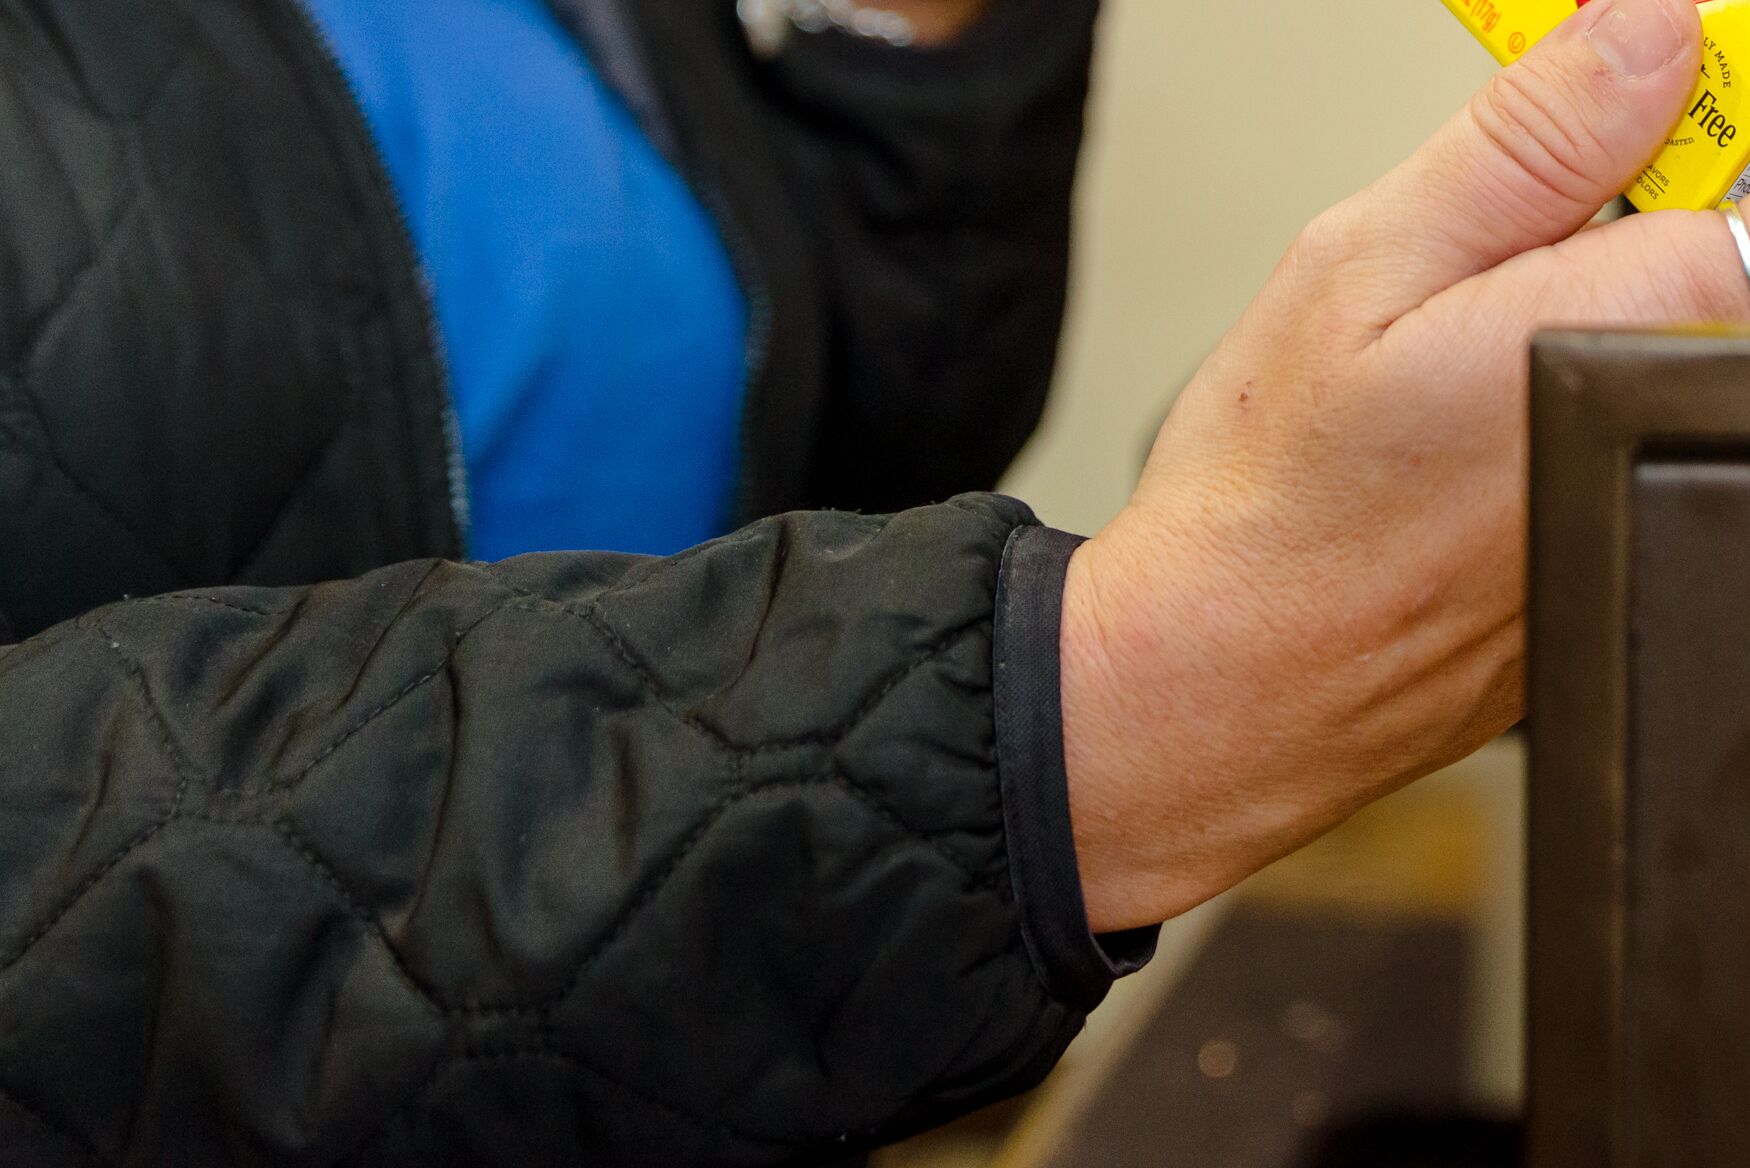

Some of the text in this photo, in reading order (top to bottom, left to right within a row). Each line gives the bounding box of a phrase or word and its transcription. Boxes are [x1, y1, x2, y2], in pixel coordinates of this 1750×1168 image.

[1714, 50, 1732, 89] MADE
[1687, 89, 1737, 148] Free
[1664, 137, 1695, 146] OASTED.
[1647, 164, 1670, 187] AVORS
[1636, 176, 1659, 200] OLORS
